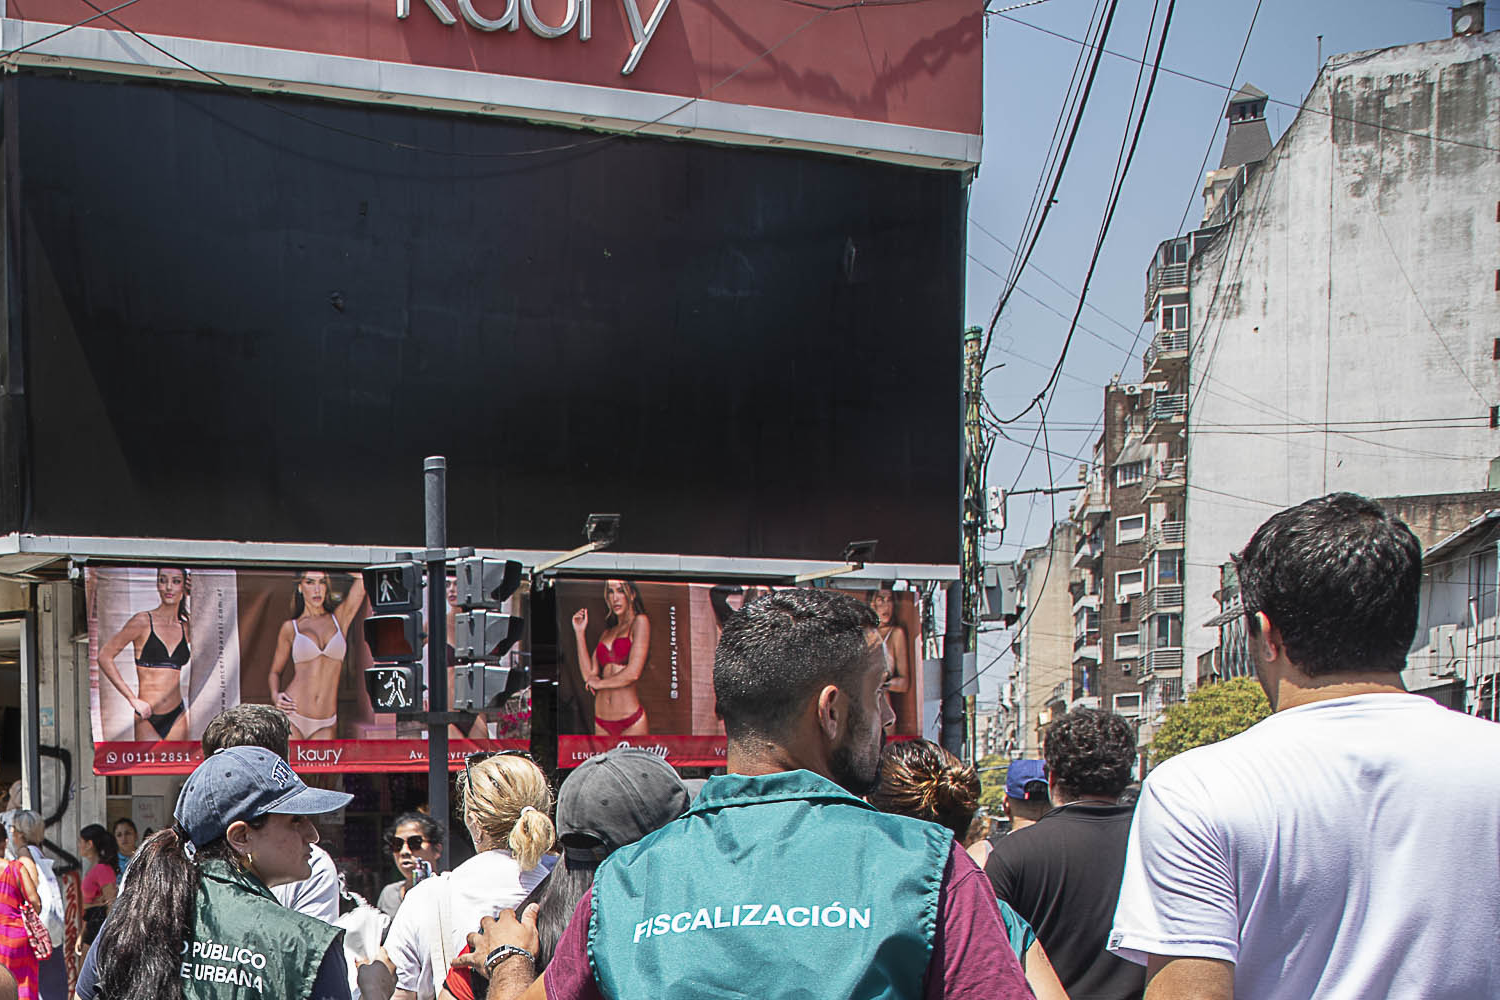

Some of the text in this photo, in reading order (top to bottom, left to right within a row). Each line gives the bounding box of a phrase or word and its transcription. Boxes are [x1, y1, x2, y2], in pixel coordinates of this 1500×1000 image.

[122, 752, 155, 764] (011)
[160, 752, 191, 763] 2851
[297, 745, 343, 765] kaury
[409, 749, 426, 760] Av.
[632, 901, 871, 944] FISCALIZACIÓN
[192, 939, 267, 970] PÚBLICO
[194, 963, 263, 993] URBANA
